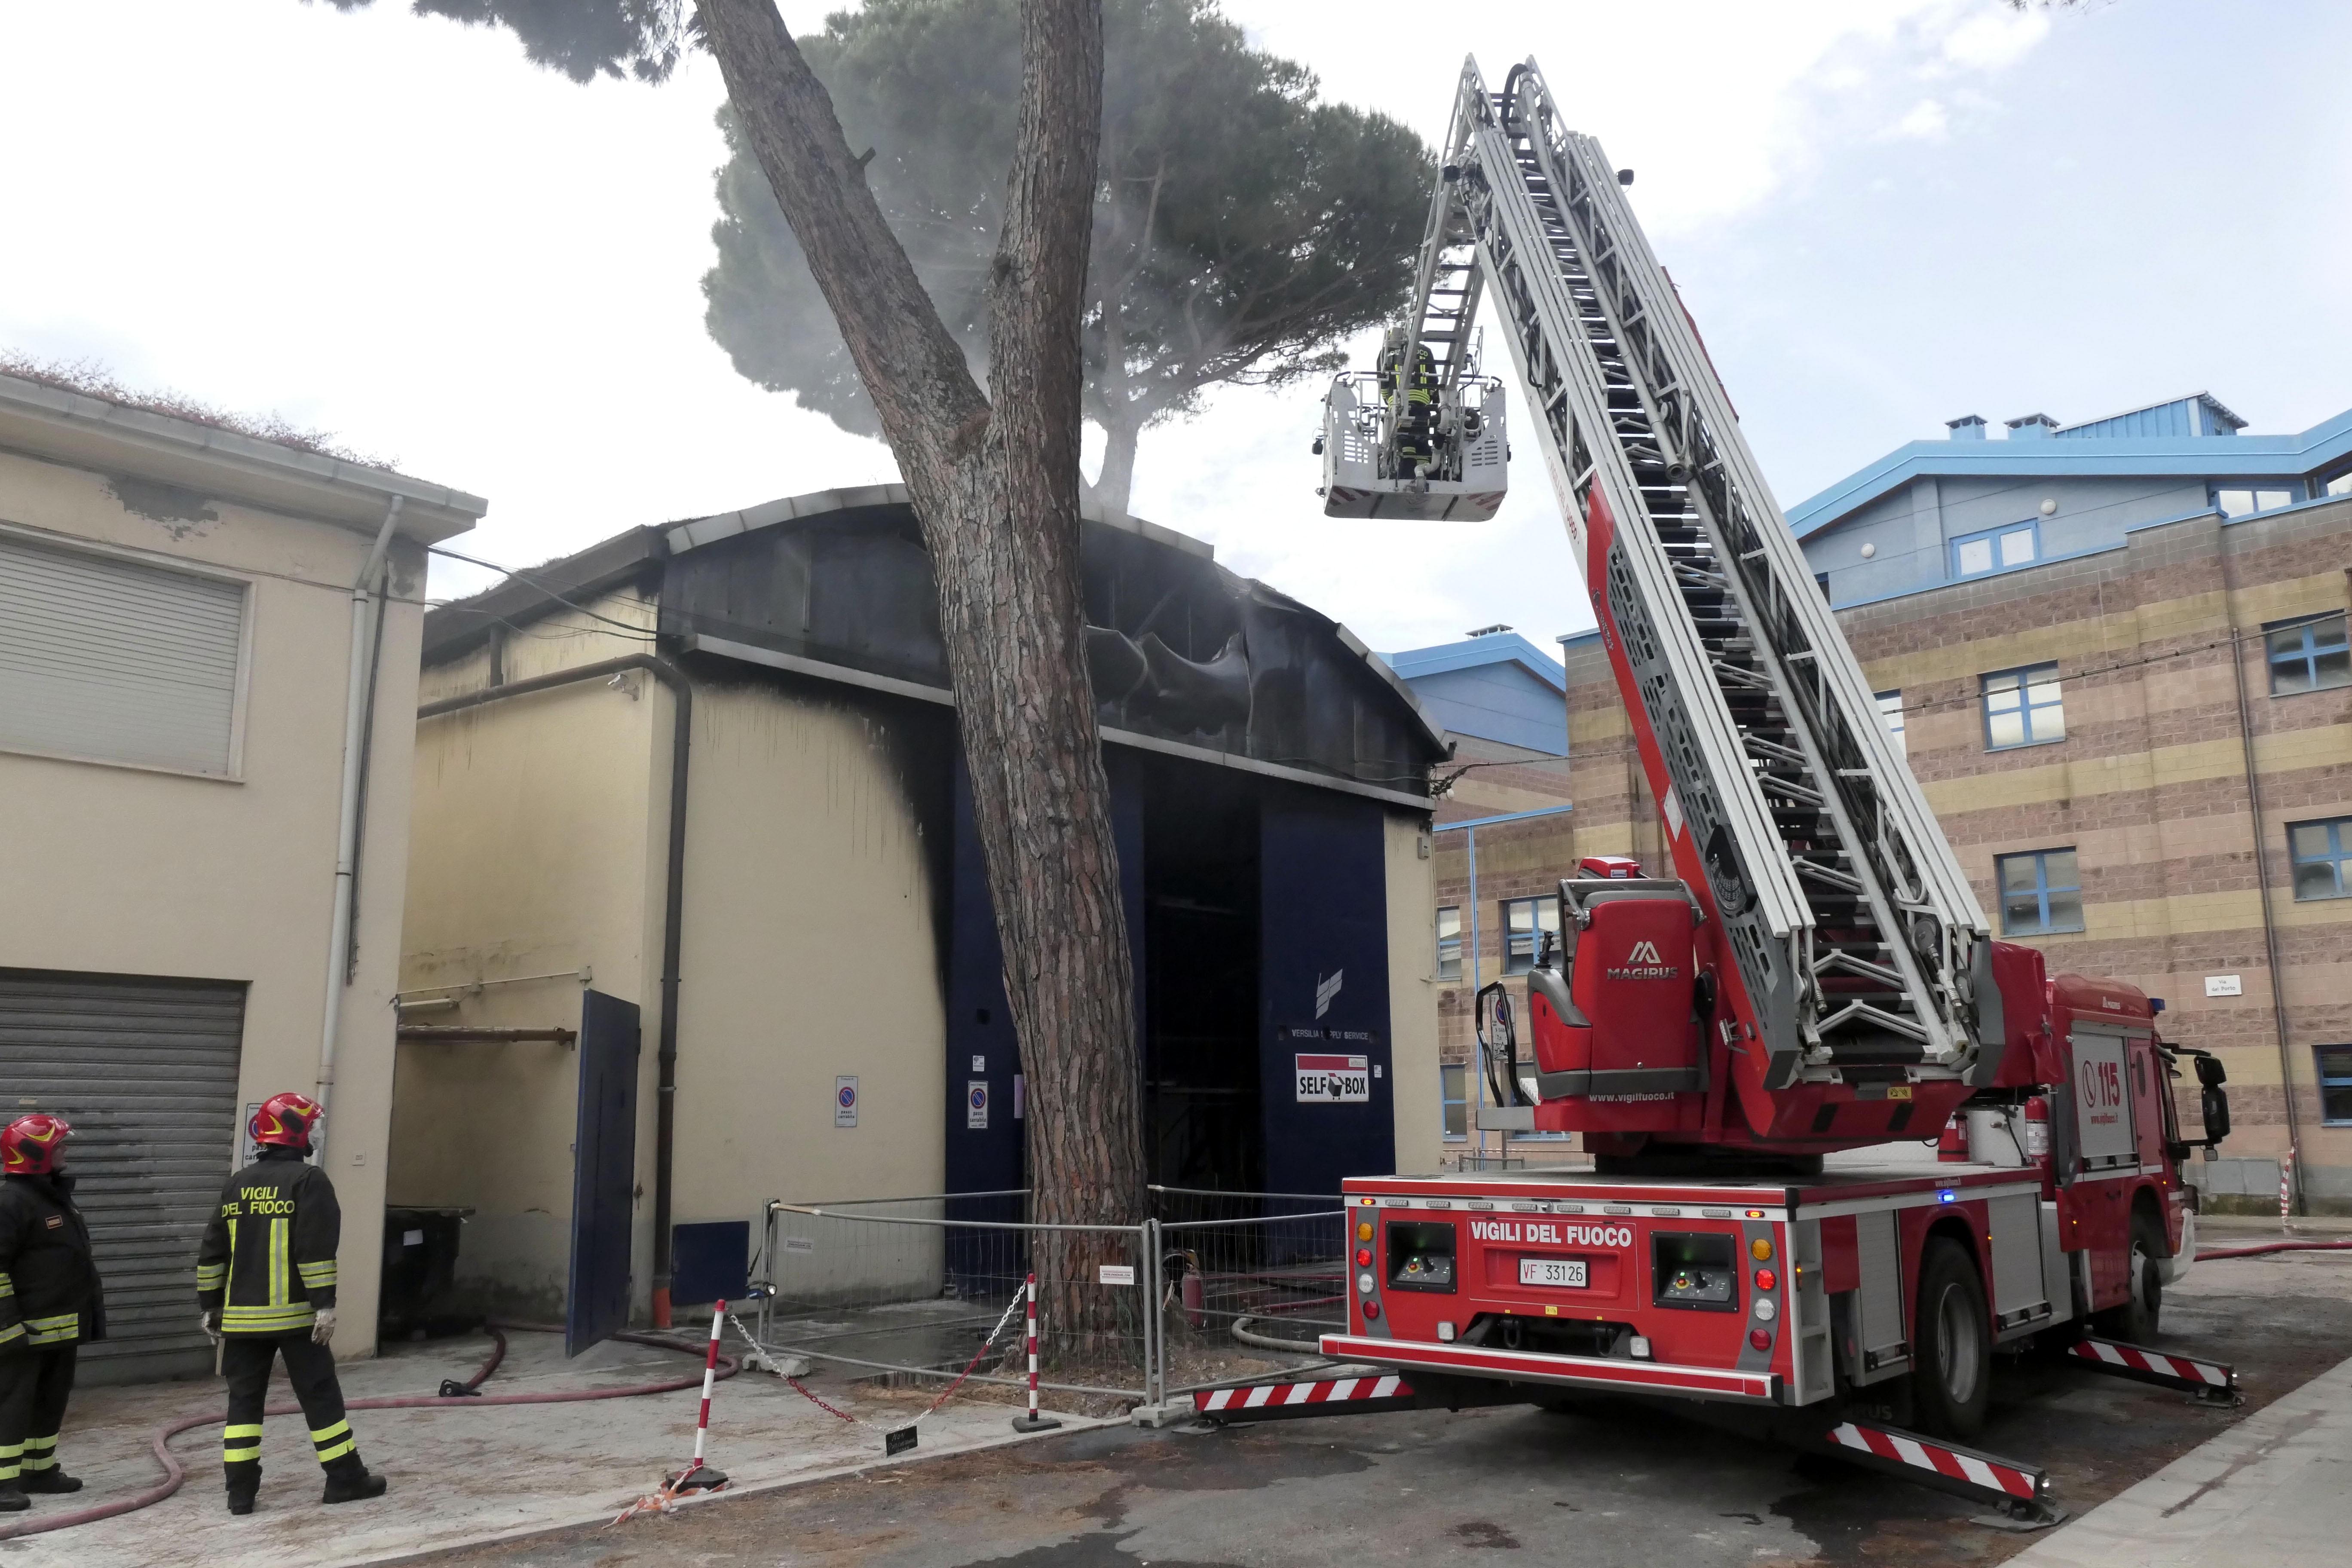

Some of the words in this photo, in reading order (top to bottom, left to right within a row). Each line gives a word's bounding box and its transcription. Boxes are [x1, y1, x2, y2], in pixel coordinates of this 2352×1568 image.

[1607, 967, 1678, 980] MAGIRUS
[1292, 1029, 1319, 1038] VERSILIA
[1344, 1031, 1368, 1040] SERVICE
[1300, 1076, 1326, 1094] SELF
[1345, 1077, 1366, 1094] BOX
[2098, 1062, 2120, 1106] 115
[1589, 1091, 1675, 1103] www.vigilfuoco.it
[241, 1186, 279, 1200] VIGILI
[221, 1202, 242, 1217] DEL
[250, 1200, 295, 1214] FUOCO
[1471, 1222, 1521, 1241] VIGILI
[1526, 1224, 1561, 1243] DEL
[1567, 1225, 1632, 1247] FUOCO
[1523, 1264, 1537, 1279] VF
[1546, 1265, 1583, 1282] 33126
